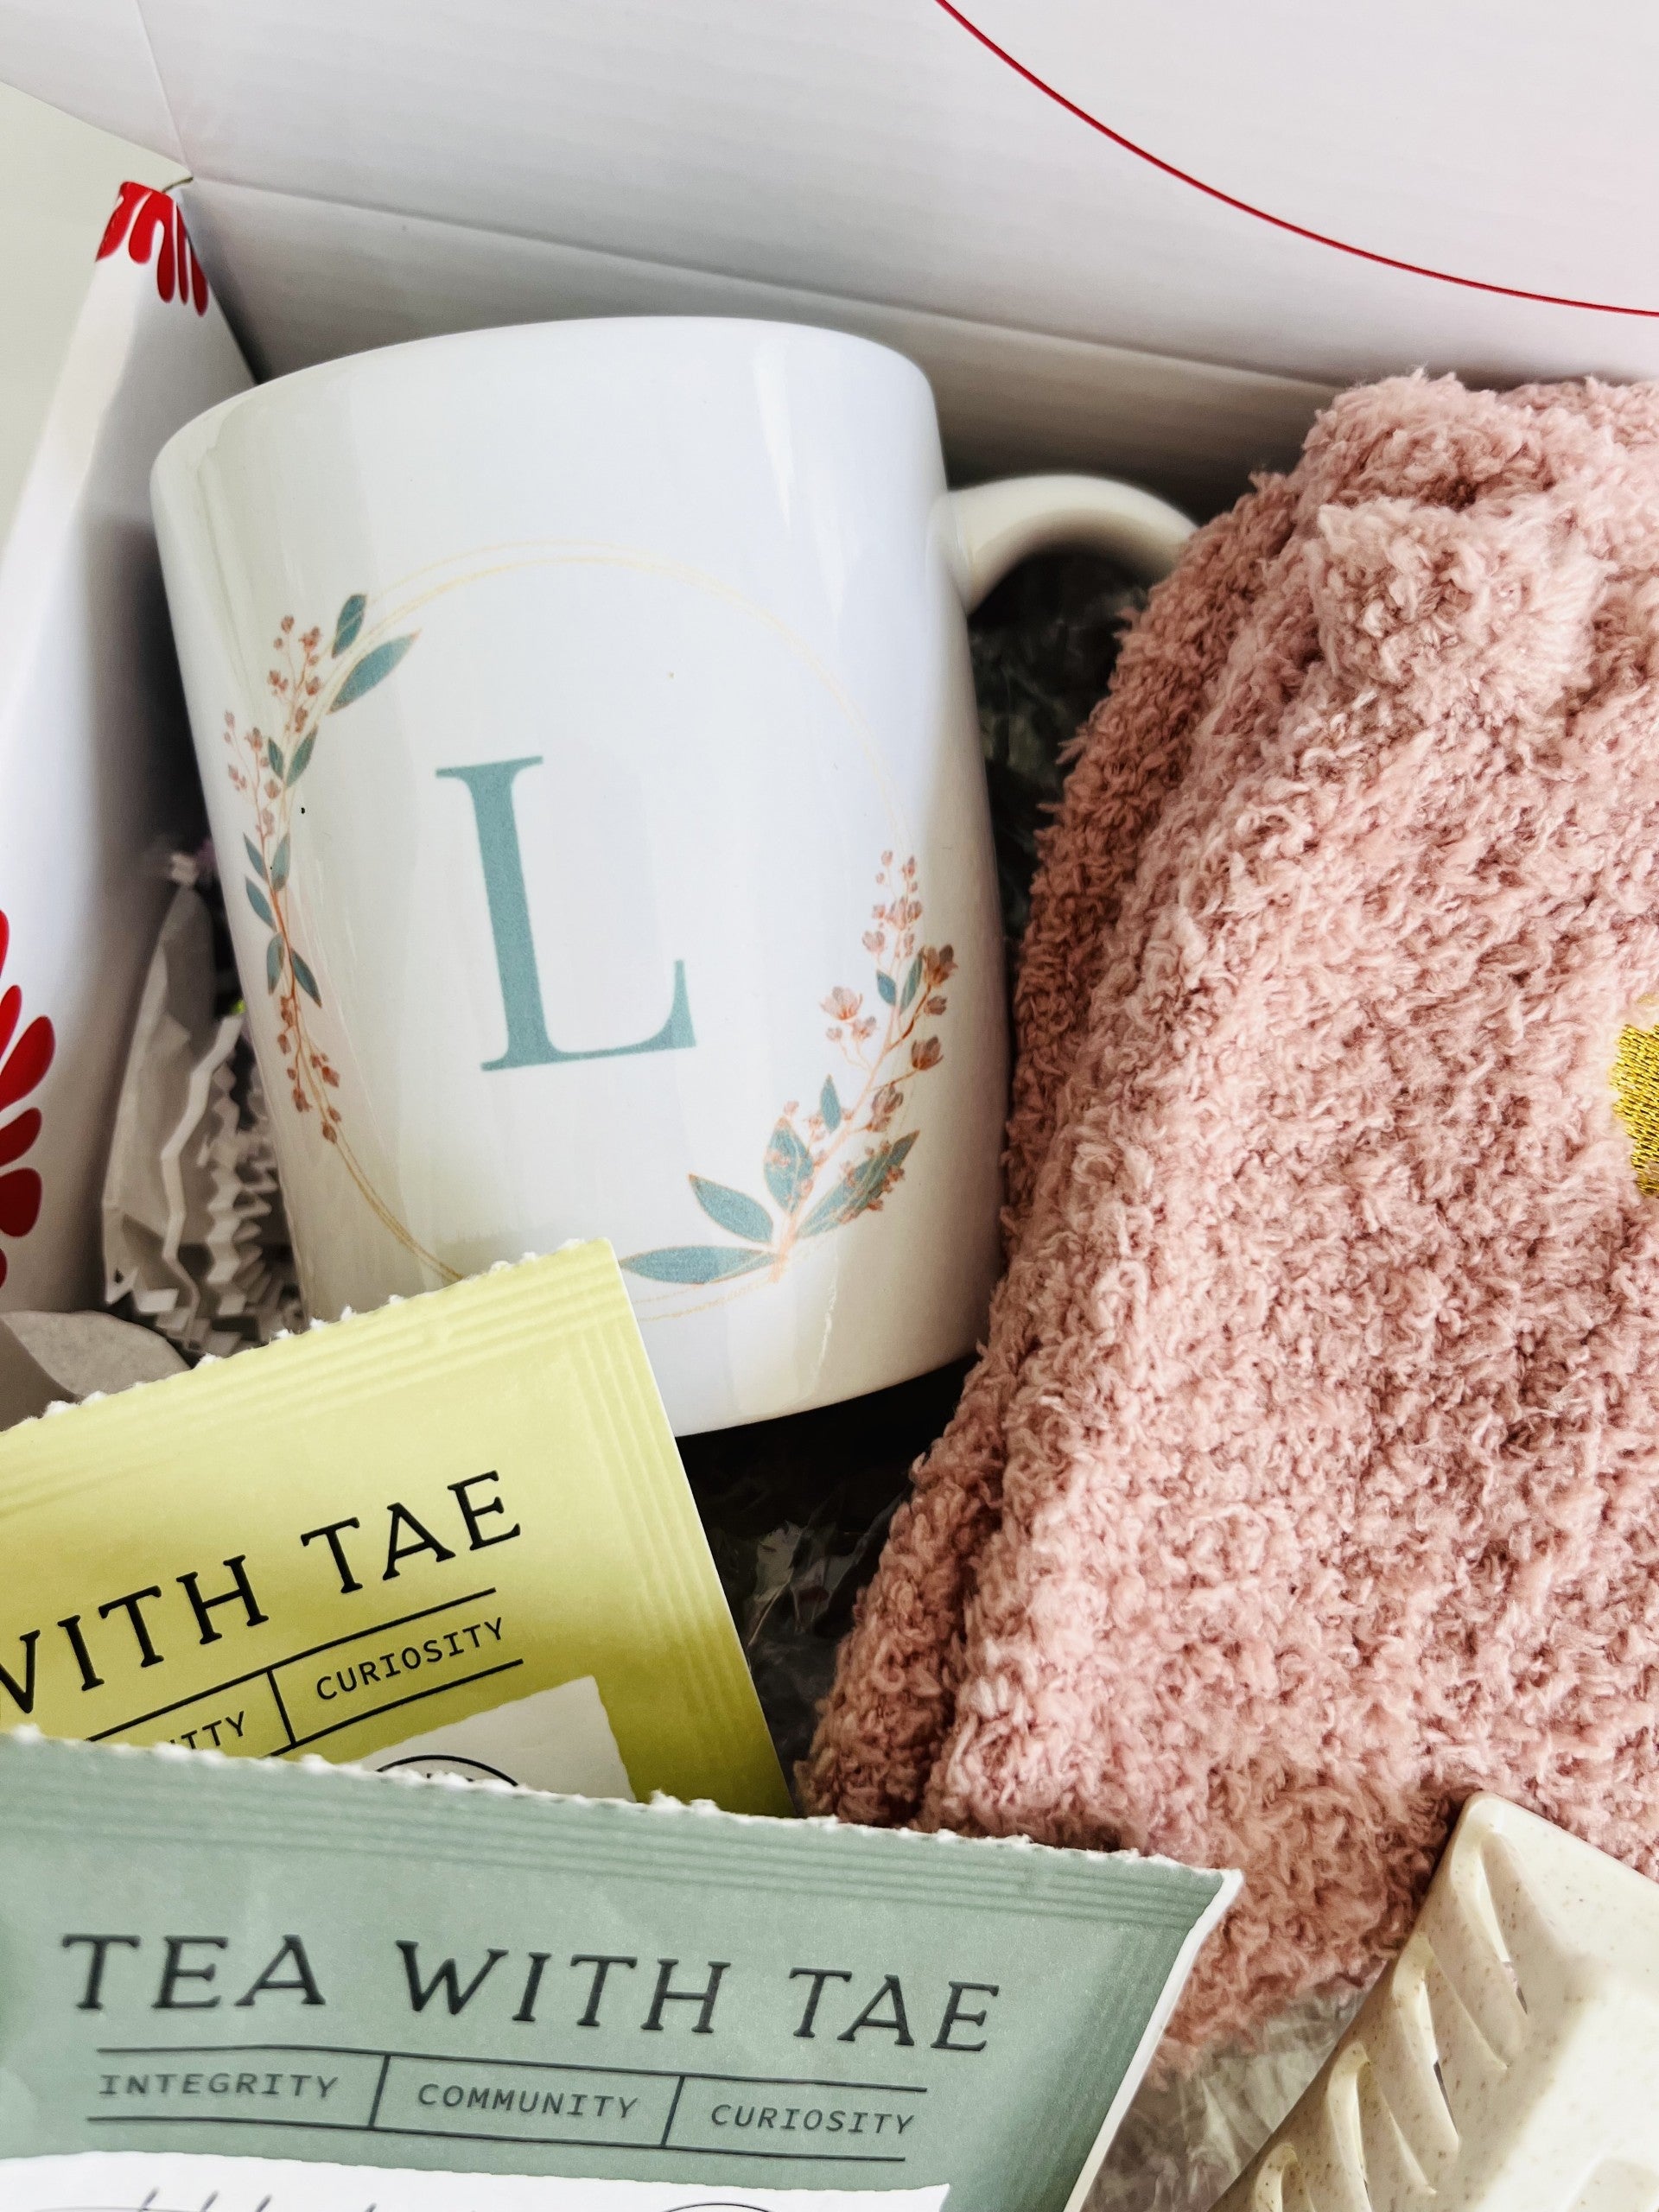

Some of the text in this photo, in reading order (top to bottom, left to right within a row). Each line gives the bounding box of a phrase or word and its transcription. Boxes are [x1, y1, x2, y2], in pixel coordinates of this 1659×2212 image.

[435, 756, 696, 1071] L
[300, 1470, 521, 1594] TAE
[316, 1617, 503, 1700] CURIOSITY
[61, 1934, 1000, 2052] TEA WITH TAE
[99, 2073, 916, 2135] INTEGRITY COMMUNITY CURIOSITY
